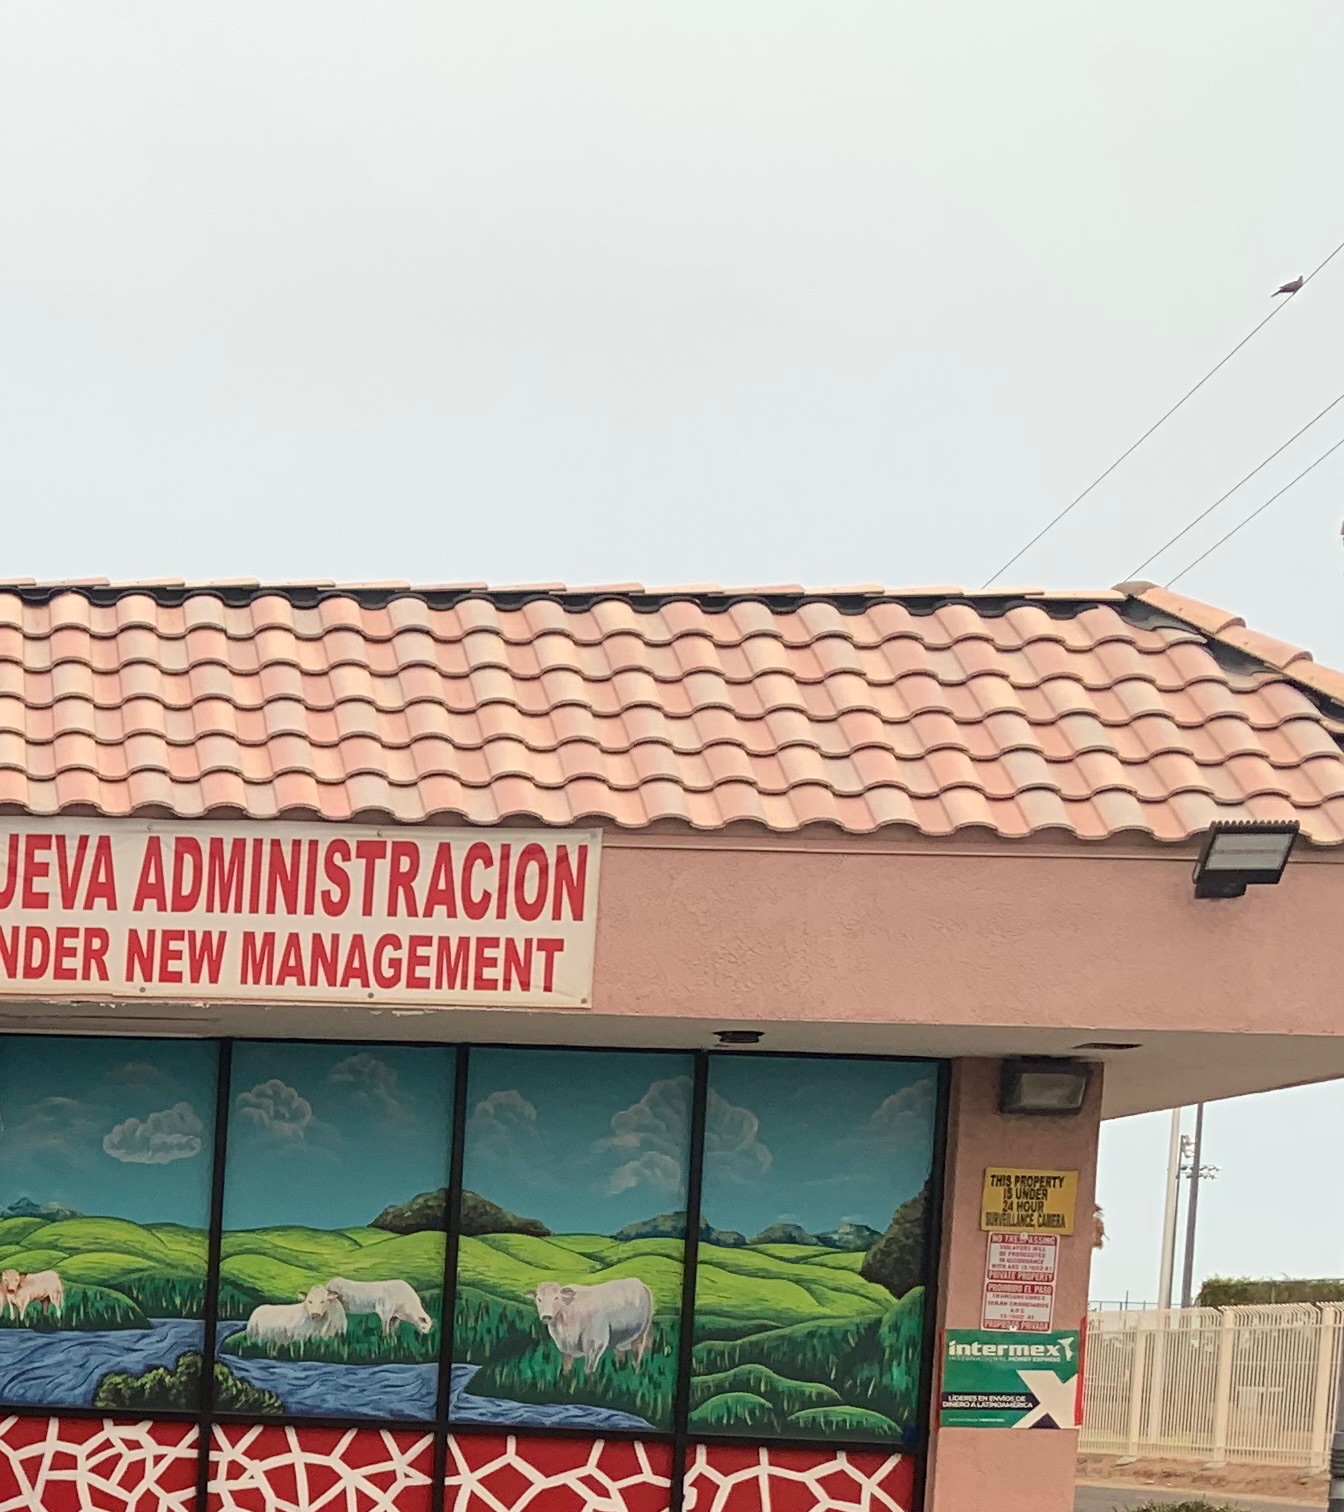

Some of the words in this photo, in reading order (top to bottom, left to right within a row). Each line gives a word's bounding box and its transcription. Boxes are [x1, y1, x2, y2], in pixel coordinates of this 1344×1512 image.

[133, 835, 589, 922] ADMINISTRACION
[125, 928, 228, 984] NEW
[240, 931, 565, 994] MANAGEMENT
[990, 1174, 1012, 1187] THIS
[1014, 1175, 1065, 1188] PROPERTY
[1003, 1188, 1012, 1200] IS
[1016, 1188, 1048, 1201] UNDER
[1002, 1200, 1013, 1212] 24
[1016, 1201, 1044, 1213] HOUR
